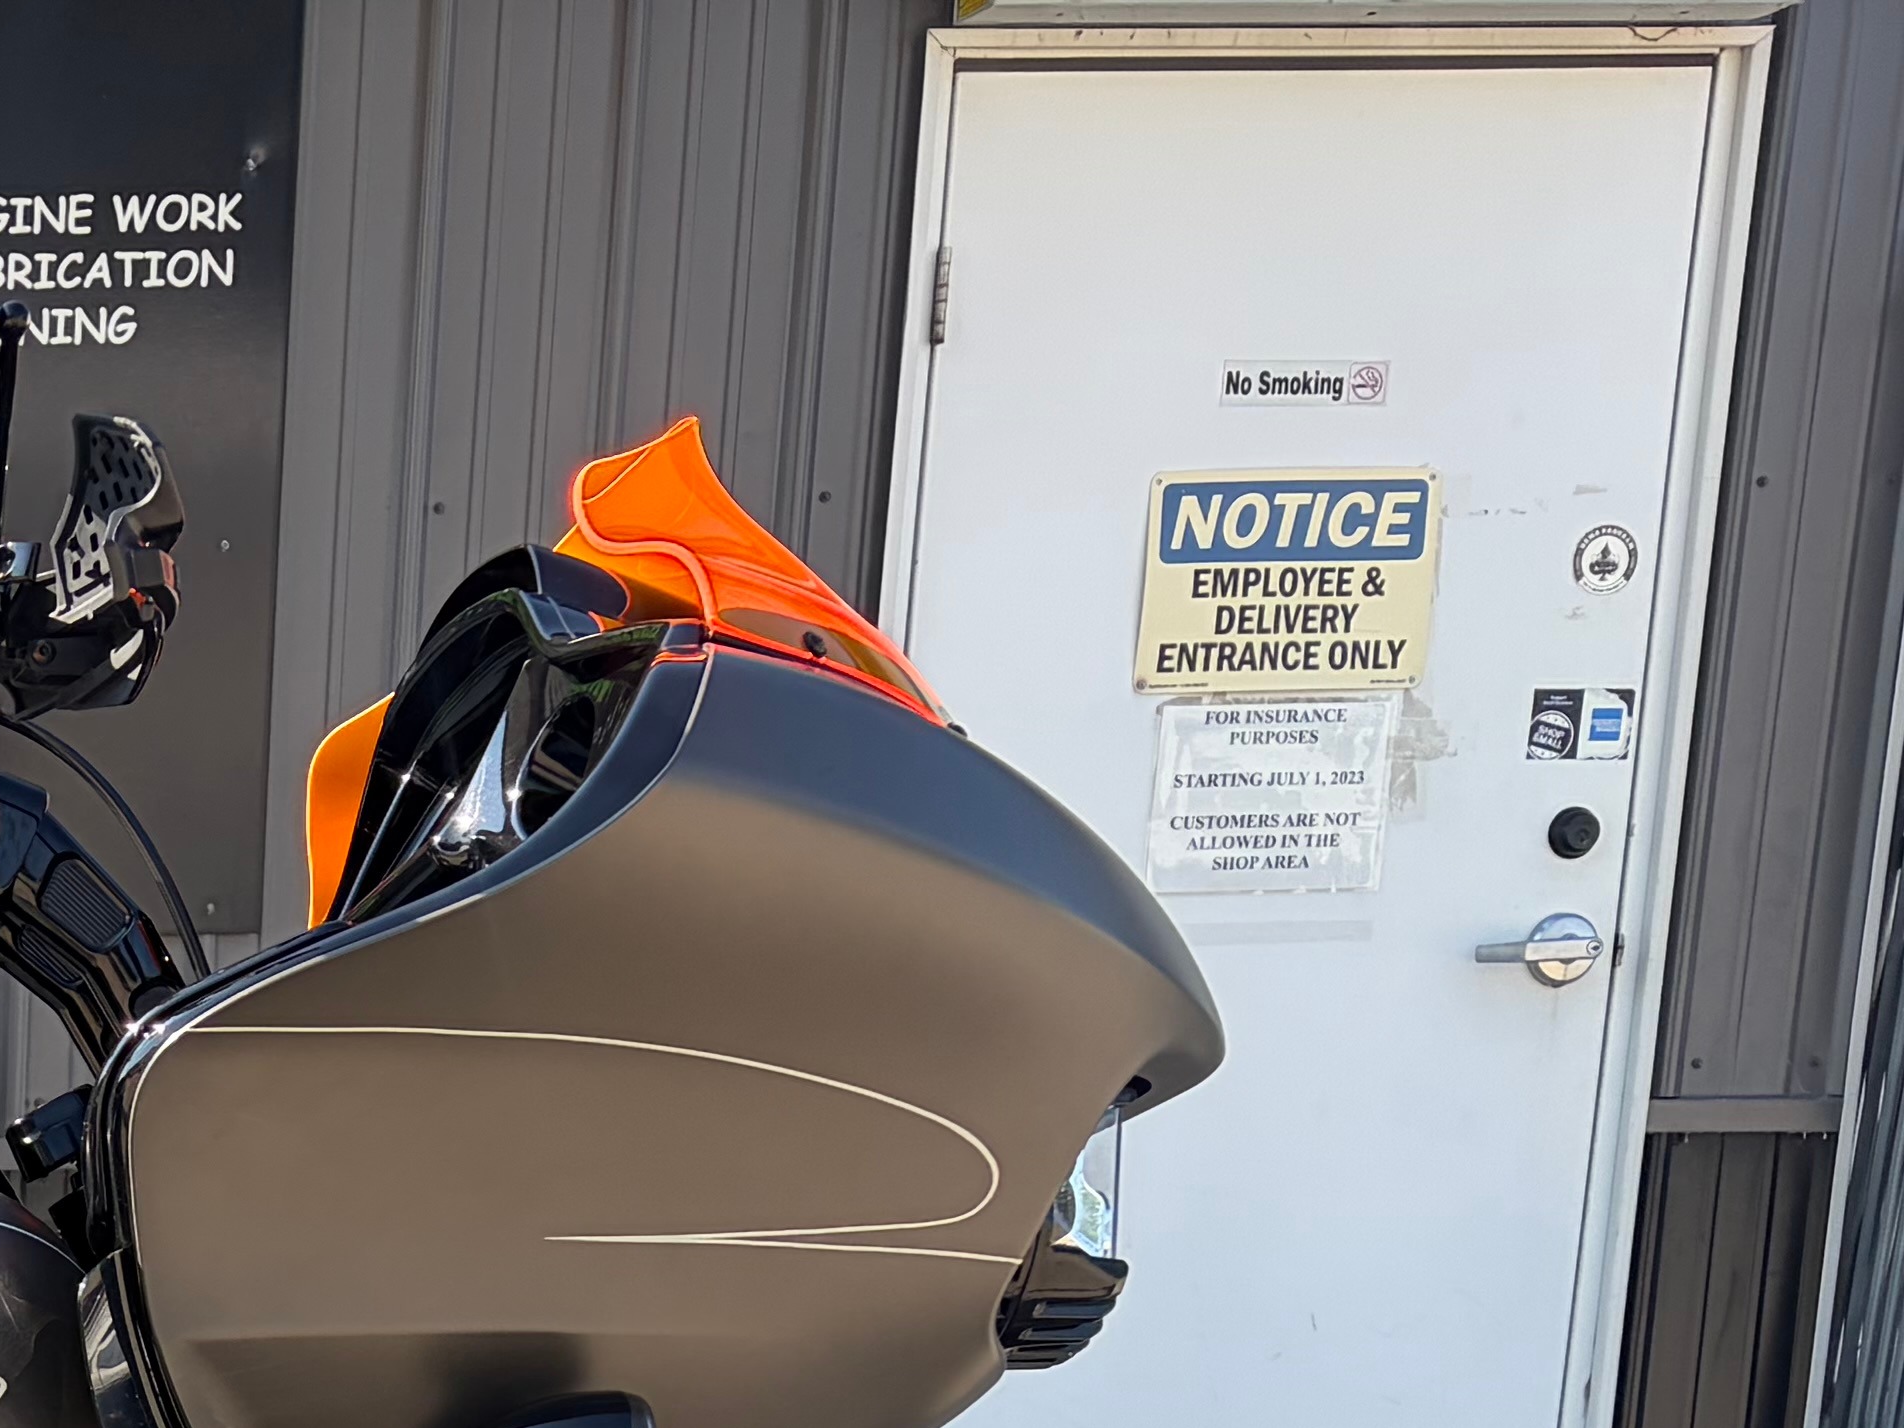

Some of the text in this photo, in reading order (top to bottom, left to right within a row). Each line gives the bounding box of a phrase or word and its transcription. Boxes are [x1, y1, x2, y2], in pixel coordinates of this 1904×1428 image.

[112, 192, 243, 233] WORK
[1224, 369, 1346, 402] No Smoking
[1169, 490, 1423, 550] NOTICE
[1191, 566, 1386, 599] EMPLOYEE &
[1214, 603, 1360, 636] DELIVERY
[1156, 639, 1408, 673] ENTRANCE ONLY
[1204, 707, 1349, 726] FOR INSURANCE
[1228, 729, 1320, 746] PURPOSES
[1172, 770, 1366, 789] STARTING JULY 1, 2023
[1169, 811, 1362, 831] CUSTOMERS ARE NOT
[1186, 832, 1342, 852] ALLOWED IN THE
[1211, 854, 1310, 872] SHOP AREA
